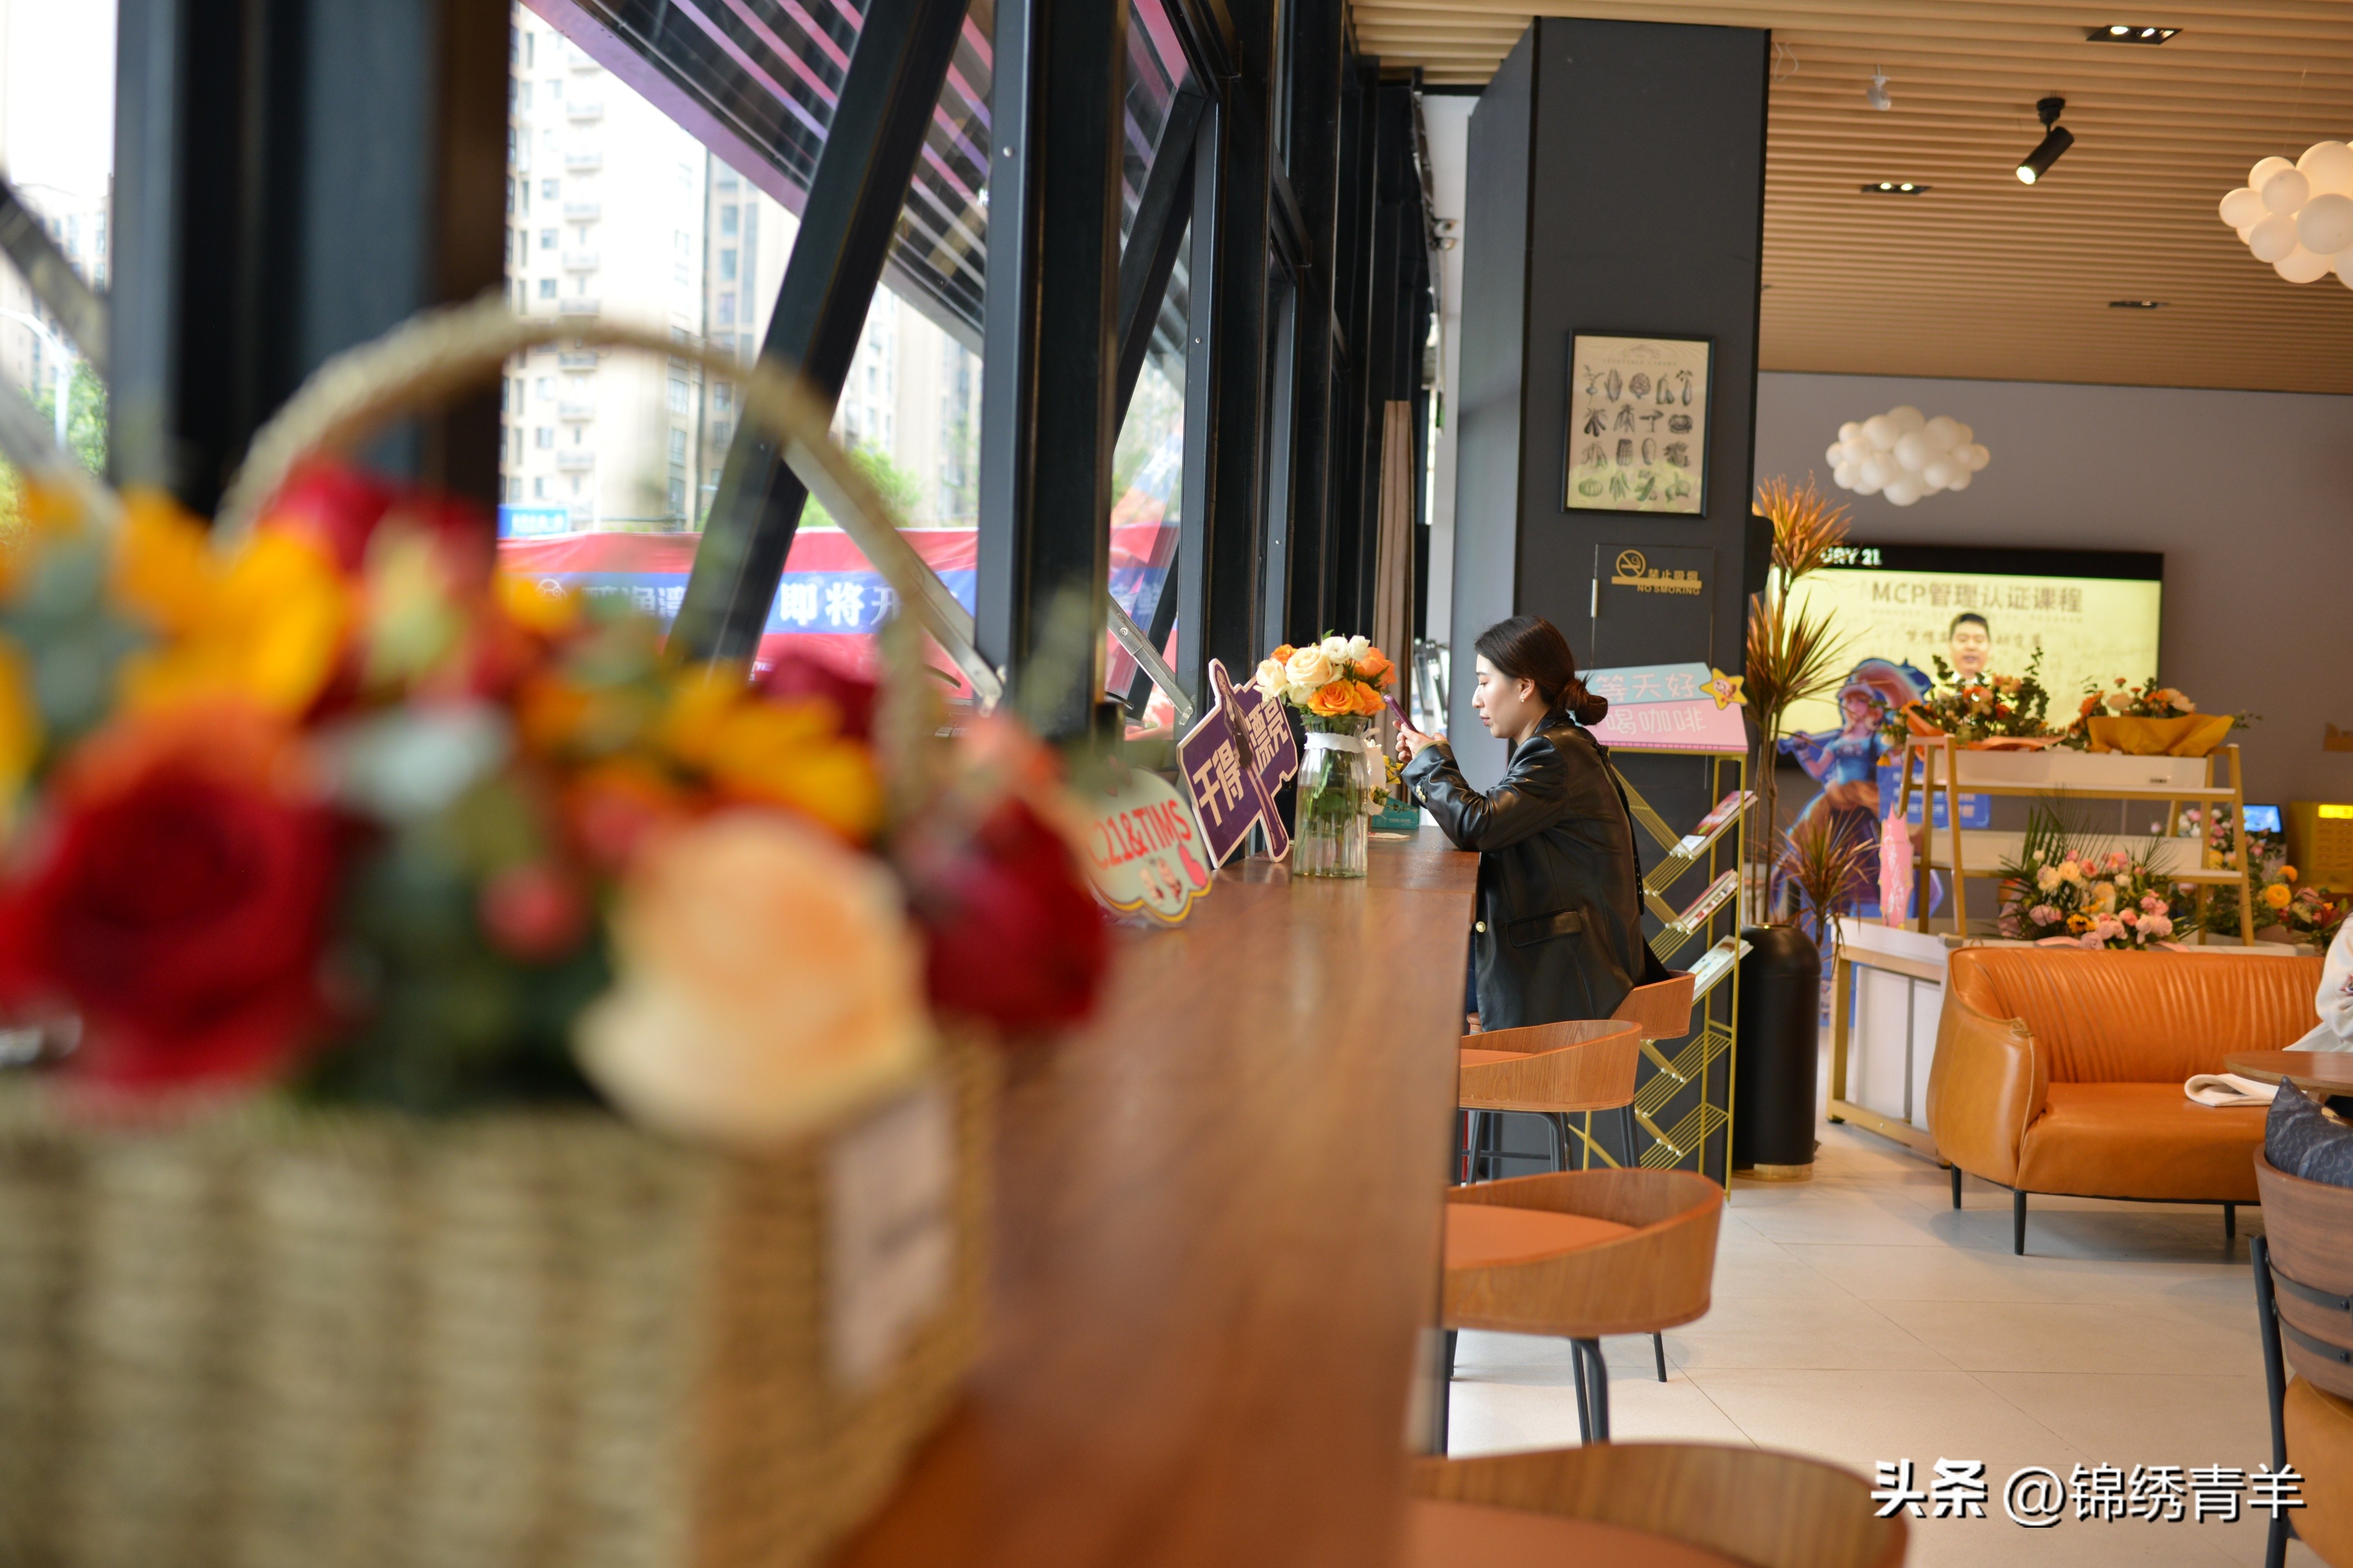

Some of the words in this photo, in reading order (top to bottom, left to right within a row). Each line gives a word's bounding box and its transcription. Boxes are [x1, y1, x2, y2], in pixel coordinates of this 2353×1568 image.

[1862, 548, 1882, 566] 21
[1648, 568, 1698, 581] 禁止吸烟
[779, 581, 958, 627] 即将开
[1637, 584, 1652, 593] NO
[1654, 586, 1700, 596] SMOKING
[1872, 581, 2083, 613] MCP管理认证课程
[1596, 672, 1696, 703] 等天好
[1605, 706, 1707, 735] 喝咖啡
